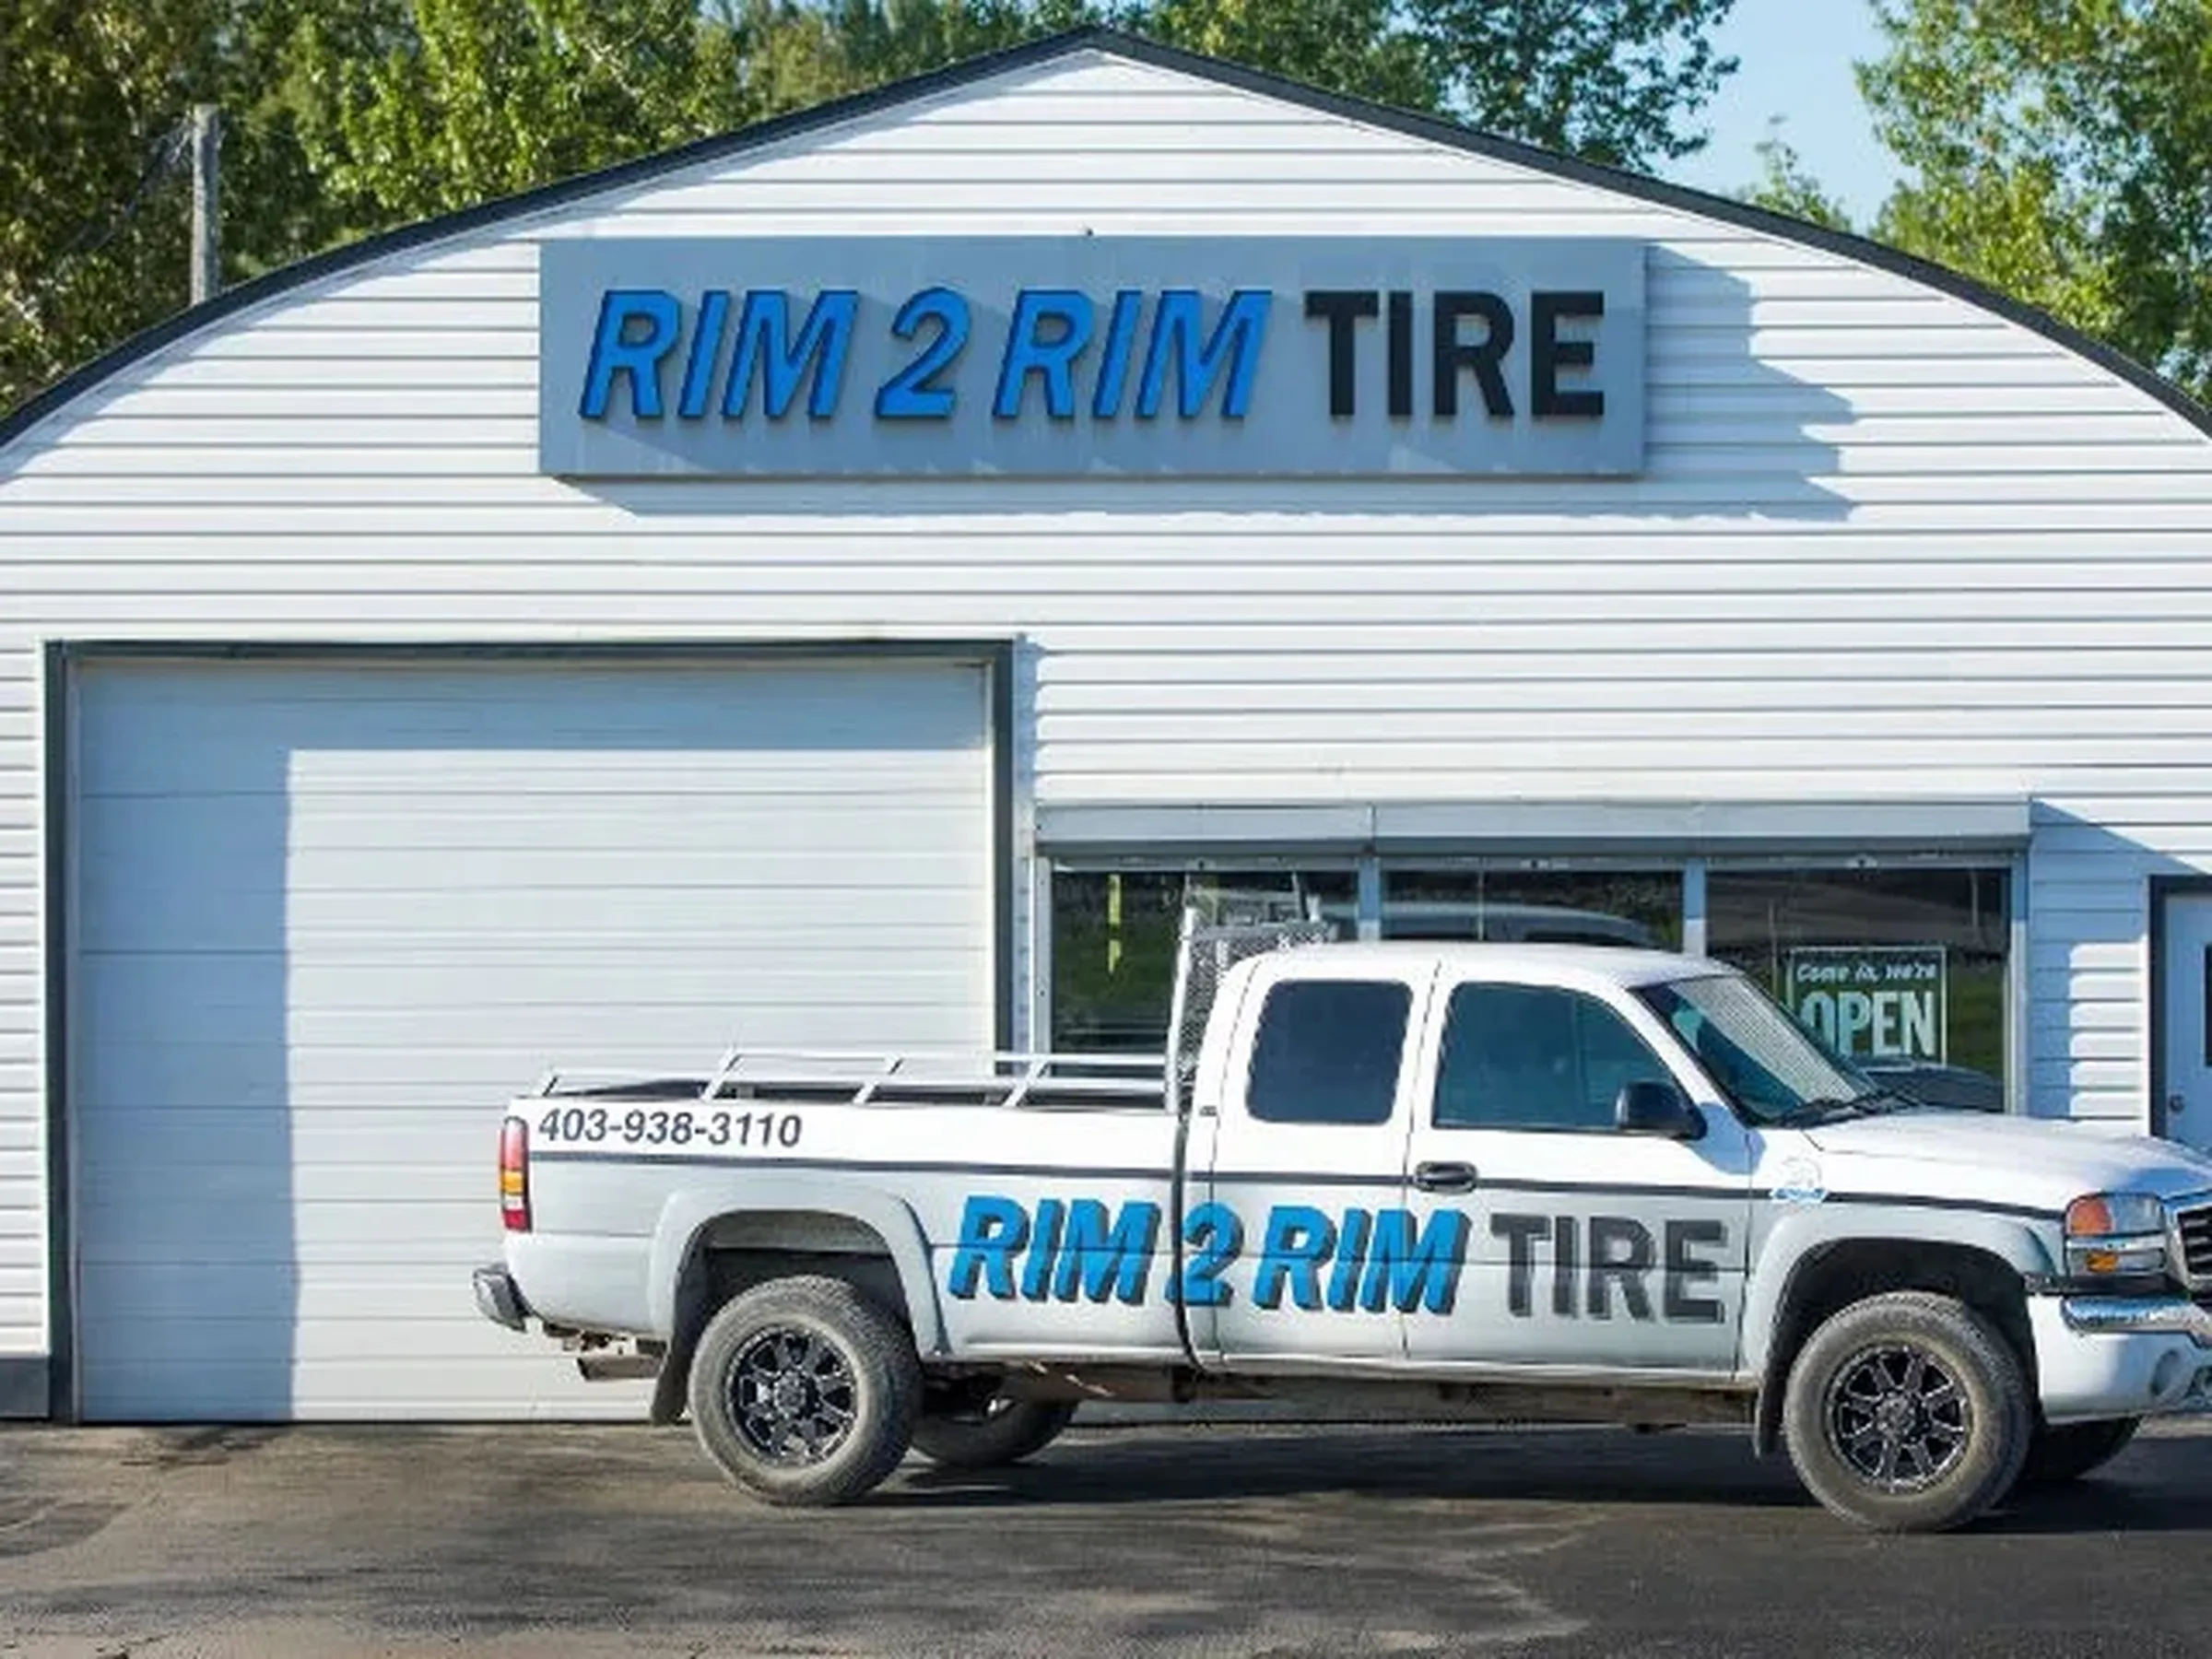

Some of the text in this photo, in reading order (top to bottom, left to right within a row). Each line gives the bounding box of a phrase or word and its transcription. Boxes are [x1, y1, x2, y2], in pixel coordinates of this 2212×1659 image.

[578, 287, 1605, 419] RIM 2 RIM TIRE
[1800, 990, 1935, 1058] OPEN
[538, 1108, 802, 1147] 403-938-3110
[948, 1194, 1728, 1324] RIM 2 RIM TIRE
